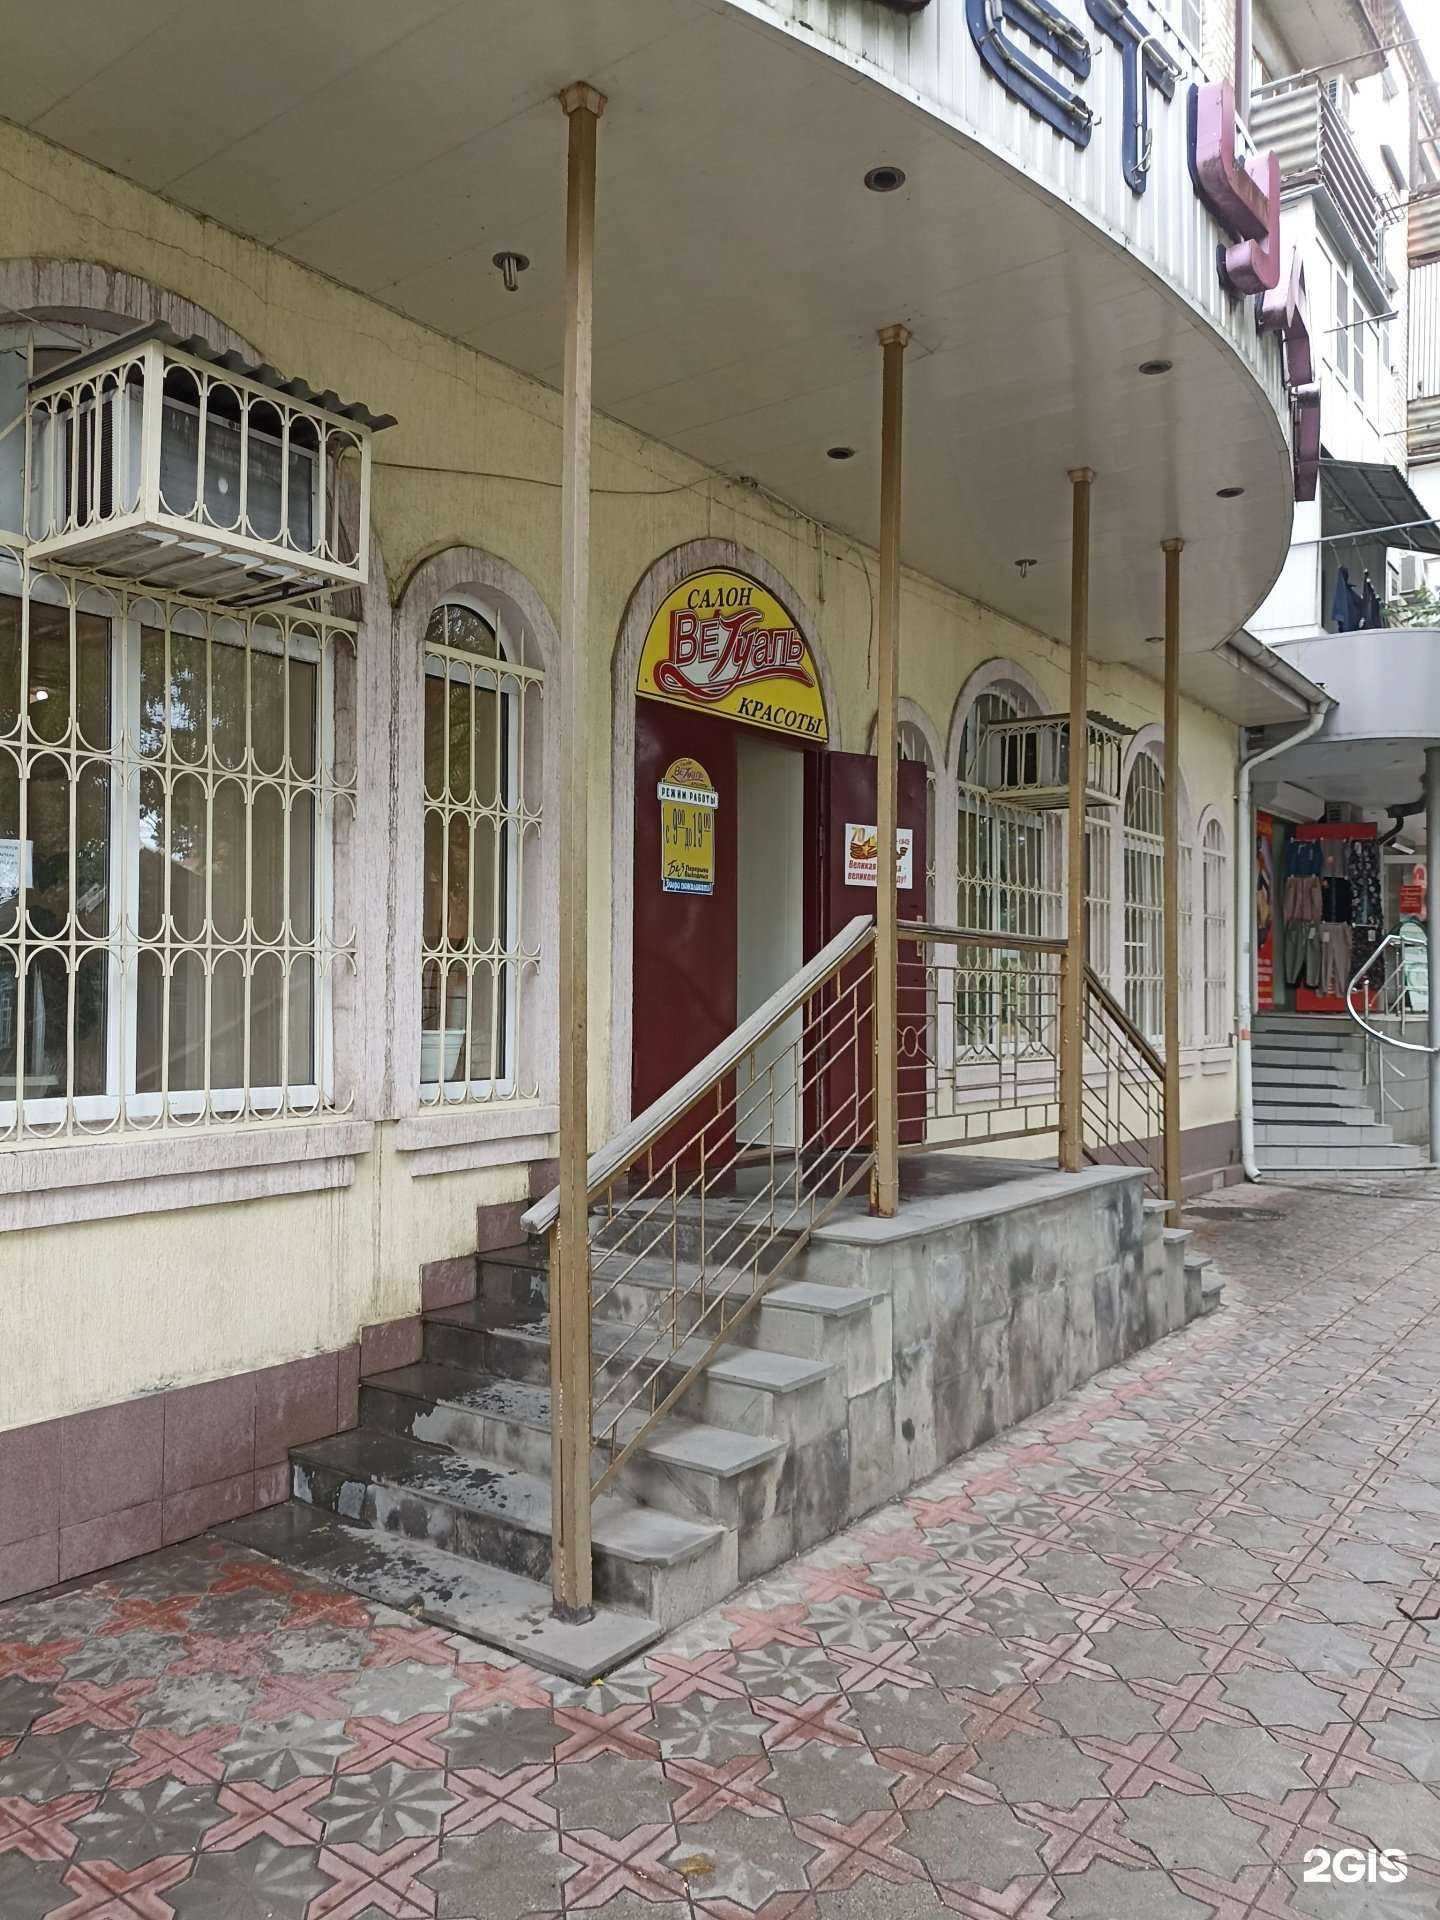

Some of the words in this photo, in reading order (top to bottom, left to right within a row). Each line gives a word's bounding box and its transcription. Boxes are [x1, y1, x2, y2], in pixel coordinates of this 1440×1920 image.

[687, 587, 753, 609] САЛОН
[738, 698, 822, 733] КРАСОТЫ
[661, 786, 687, 799] РЕЖИМ
[689, 791, 716, 805] РАБОТЫ
[668, 860, 685, 877] Без
